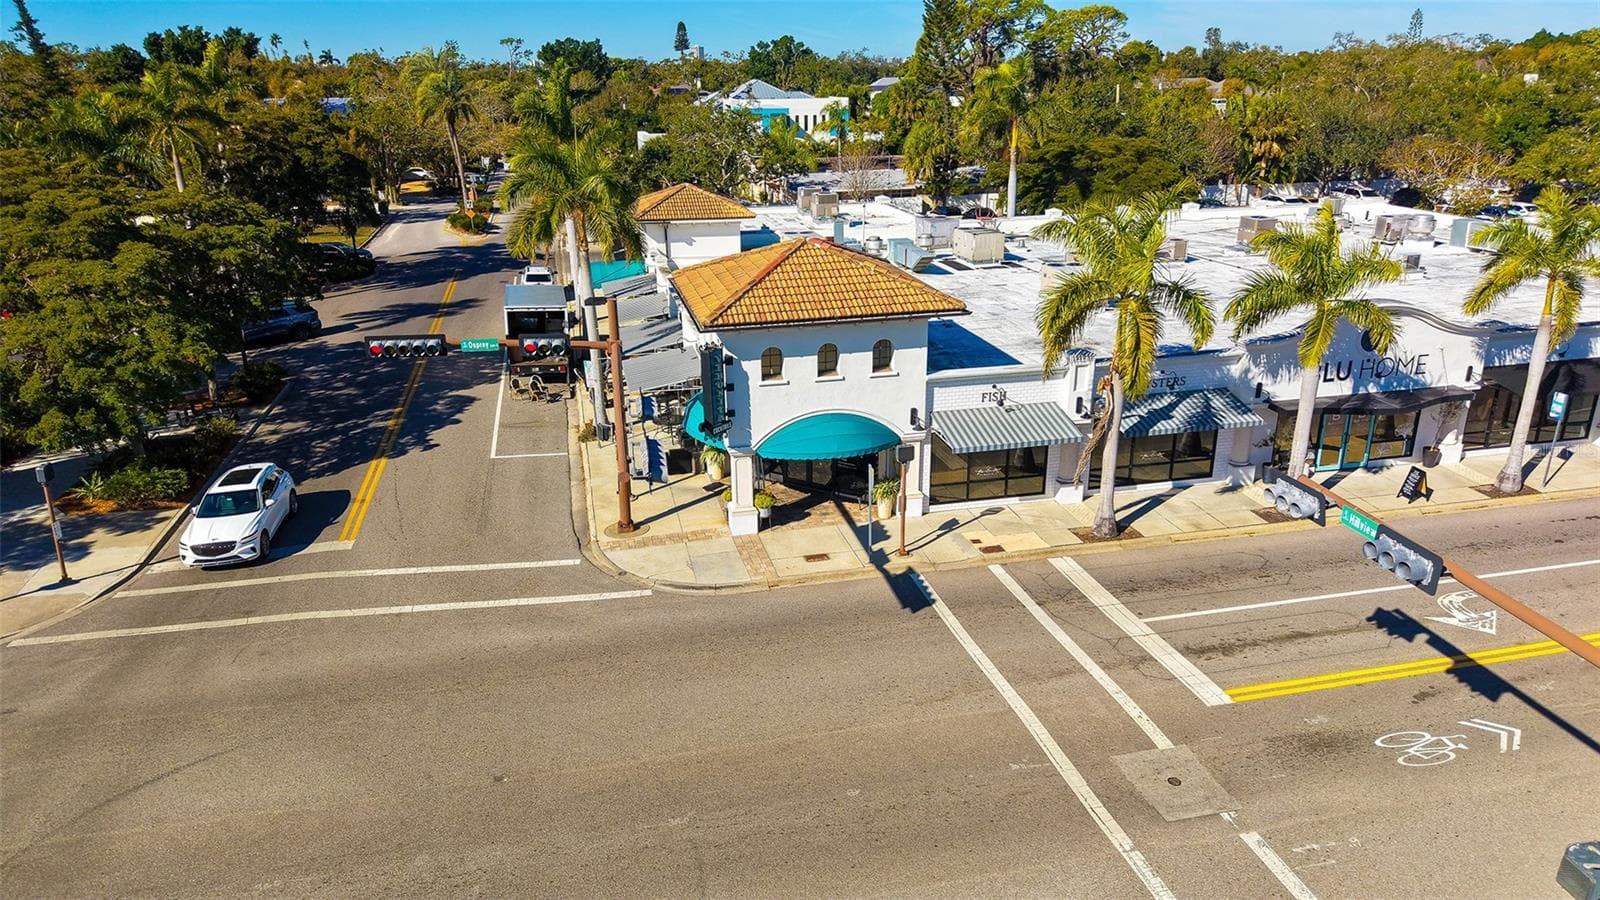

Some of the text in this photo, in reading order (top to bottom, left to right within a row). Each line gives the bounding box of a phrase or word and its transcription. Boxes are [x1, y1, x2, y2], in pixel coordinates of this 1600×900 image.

[1318, 354, 1430, 383] LU HOME
[1151, 376, 1186, 388] STERS
[981, 391, 1007, 402] FISH
